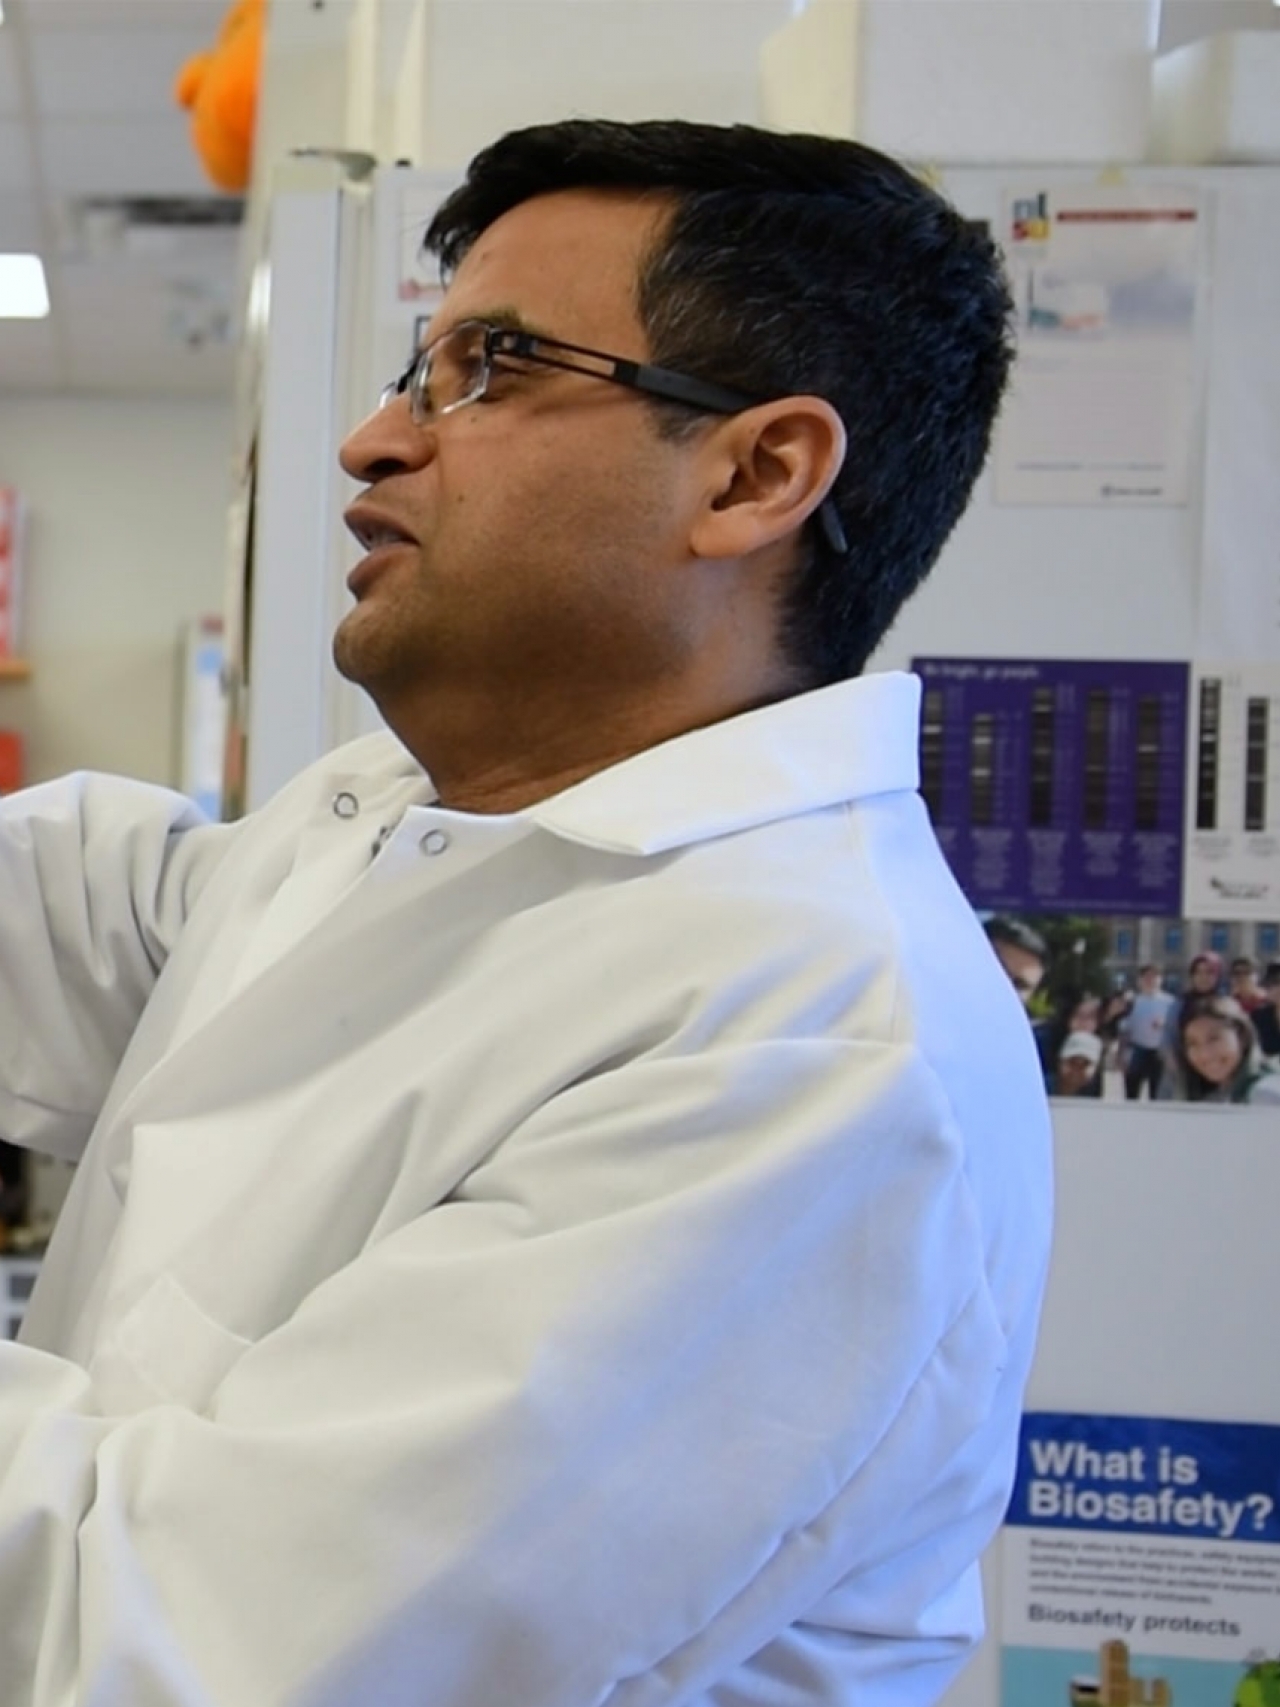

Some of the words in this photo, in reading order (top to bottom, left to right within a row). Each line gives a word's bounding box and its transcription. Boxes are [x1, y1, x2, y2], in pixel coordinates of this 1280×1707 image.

[1029, 1440, 1146, 1481] What
[1157, 1445, 1199, 1485] is
[1028, 1480, 1274, 1537] Biosafety?
[1028, 1604, 1136, 1633] Biosafety
[1143, 1611, 1241, 1637] protects
